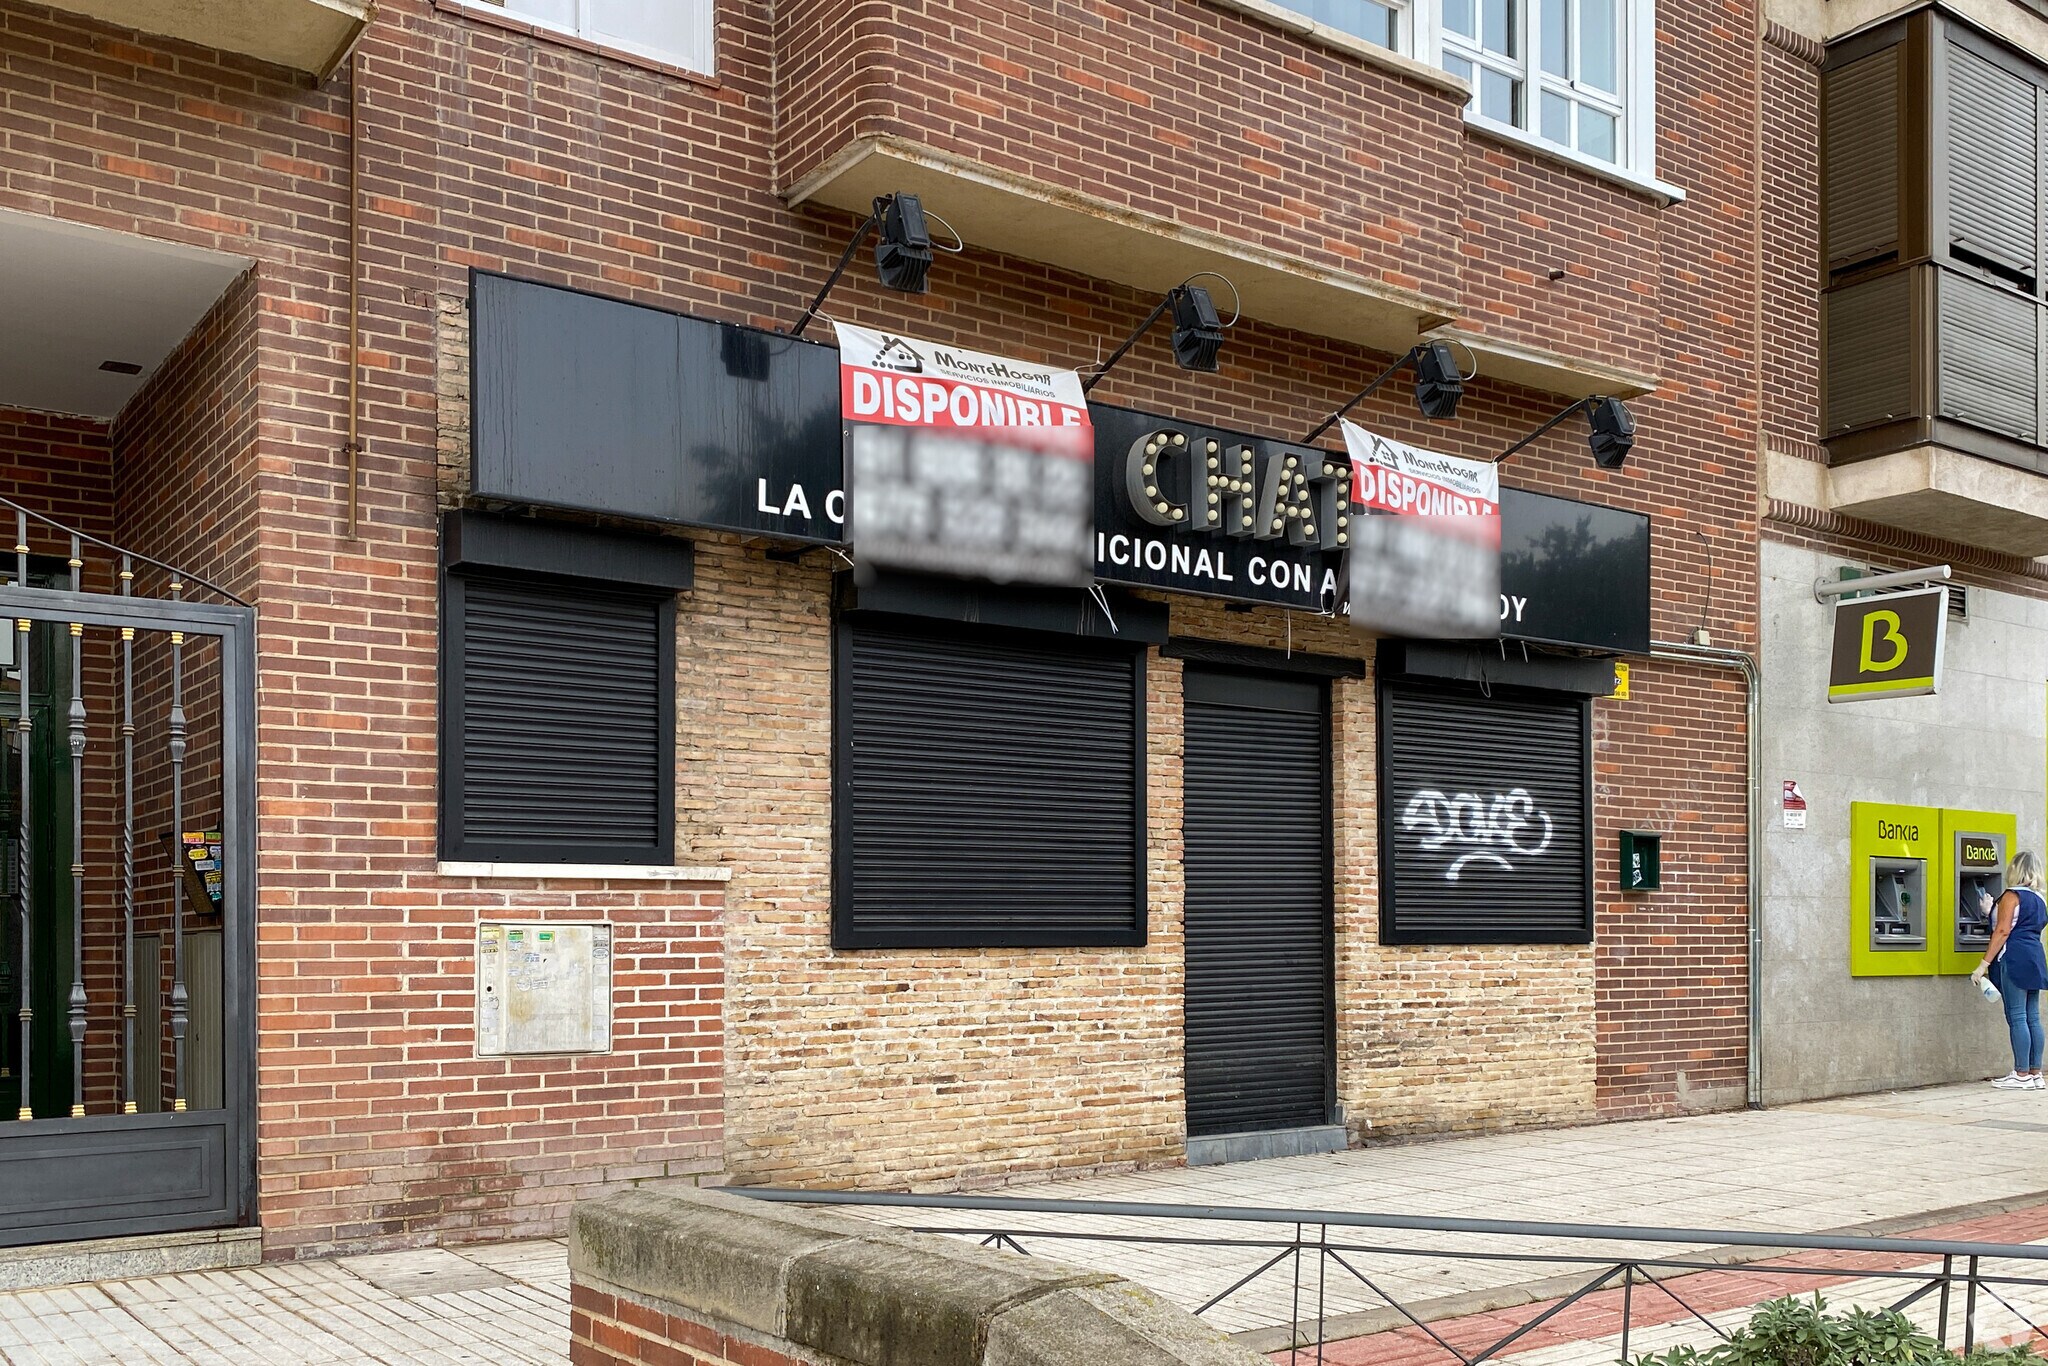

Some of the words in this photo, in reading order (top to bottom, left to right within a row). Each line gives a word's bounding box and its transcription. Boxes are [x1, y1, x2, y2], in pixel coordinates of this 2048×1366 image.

[940, 369, 989, 384] SERVICIOS
[991, 379, 1056, 398] INMOBILIARIOS
[757, 478, 812, 519] LA
[1248, 556, 1311, 592] CON
[1859, 609, 1909, 674] B
[1878, 820, 1919, 842] Bankia
[1966, 844, 1998, 862] Bankia
